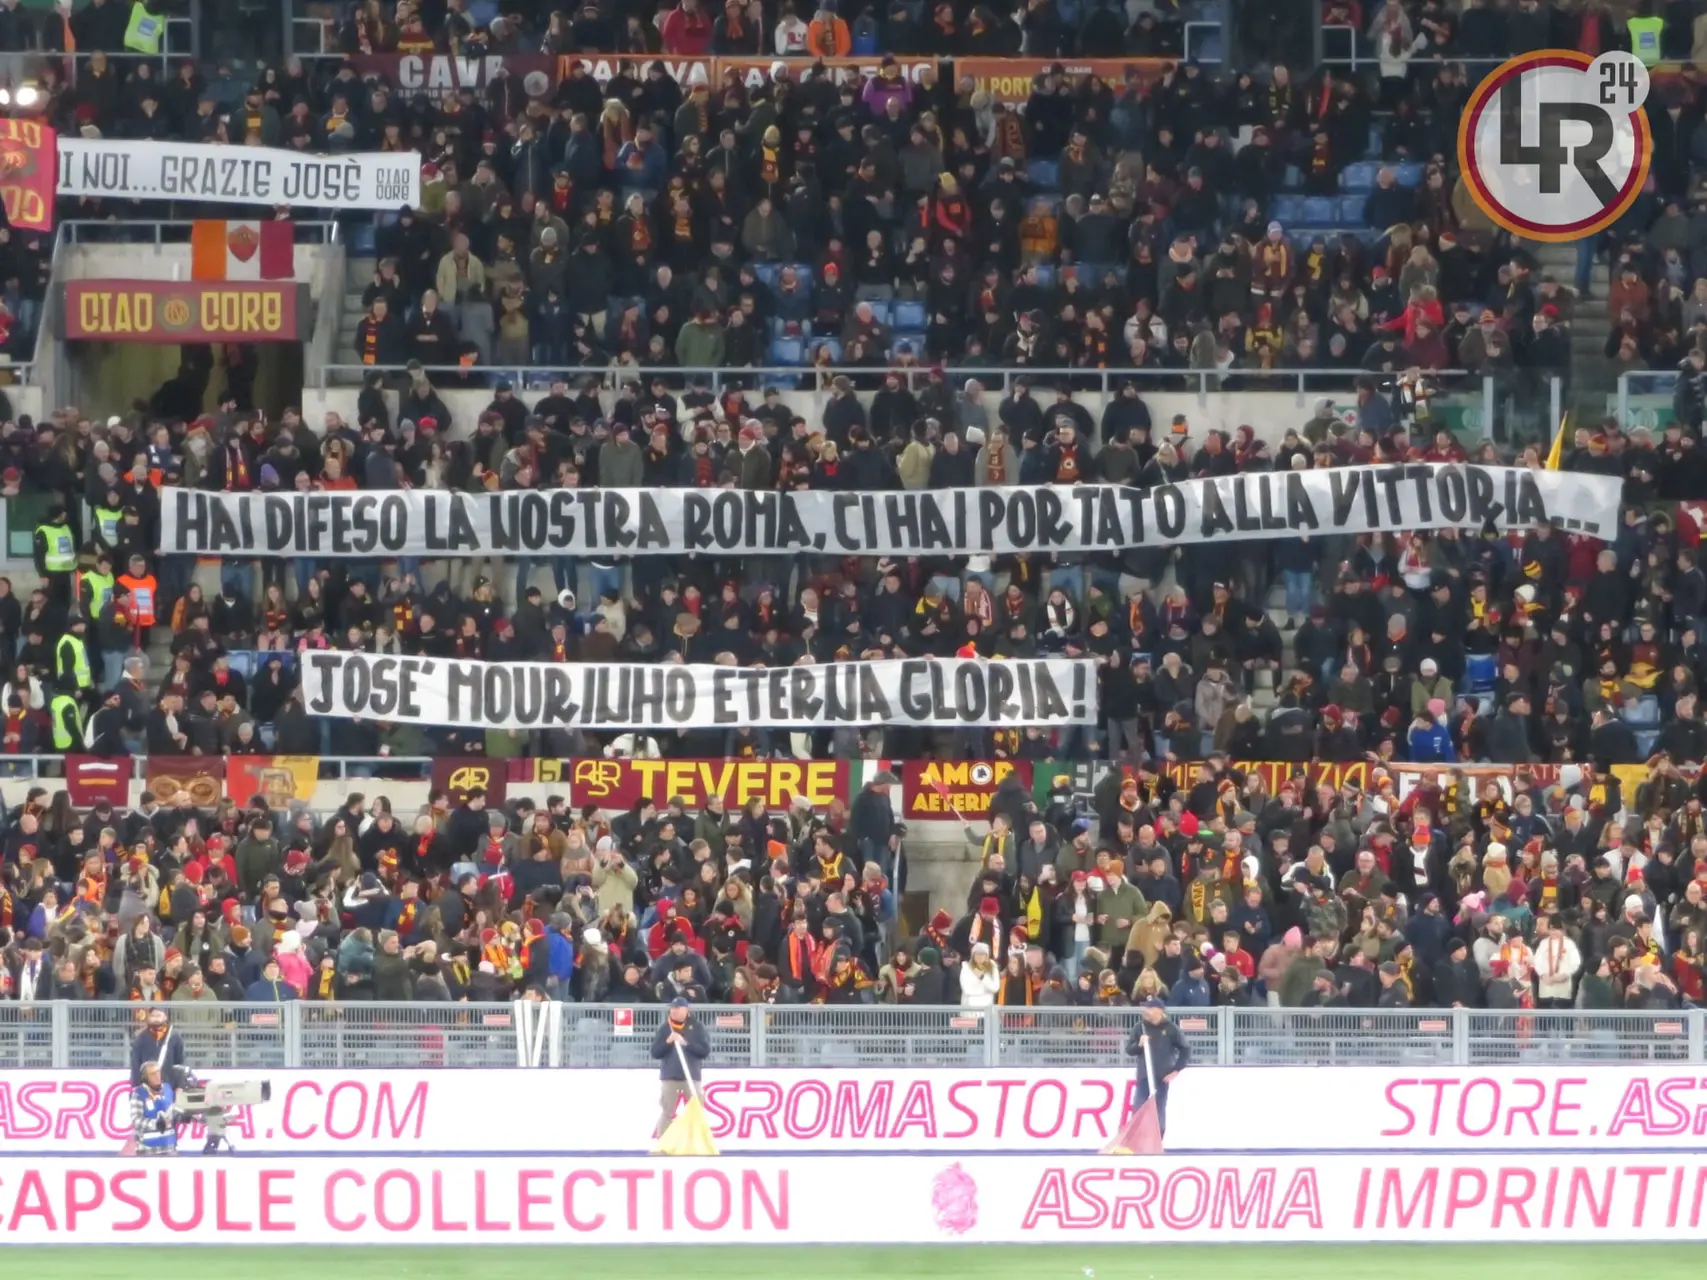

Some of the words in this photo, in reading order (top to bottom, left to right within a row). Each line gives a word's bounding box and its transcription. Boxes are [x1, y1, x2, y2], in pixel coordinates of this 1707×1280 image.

[57, 151, 74, 188] I
[283, 157, 361, 201] JOSÈ
[80, 292, 153, 333] CIAO
[201, 291, 282, 333] CORE
[175, 491, 254, 551] HAI
[265, 495, 408, 553] DIFESO
[424, 494, 481, 551] LA
[489, 491, 671, 551] NOSTRA
[684, 491, 827, 551] ROMA,
[832, 494, 878, 551] CI
[885, 491, 967, 549] HAI
[980, 484, 1187, 550] PORTATO
[1200, 473, 1320, 538] ALLA
[447, 662, 697, 725] MOURINHO
[713, 663, 893, 724] ETERNA
[900, 661, 1086, 722] GLORIA!
[631, 760, 837, 806] TEVERE
[0, 1169, 296, 1232] APSULE
[324, 1168, 789, 1232] COLLECTION
[1021, 1167, 1324, 1230] ASROMA
